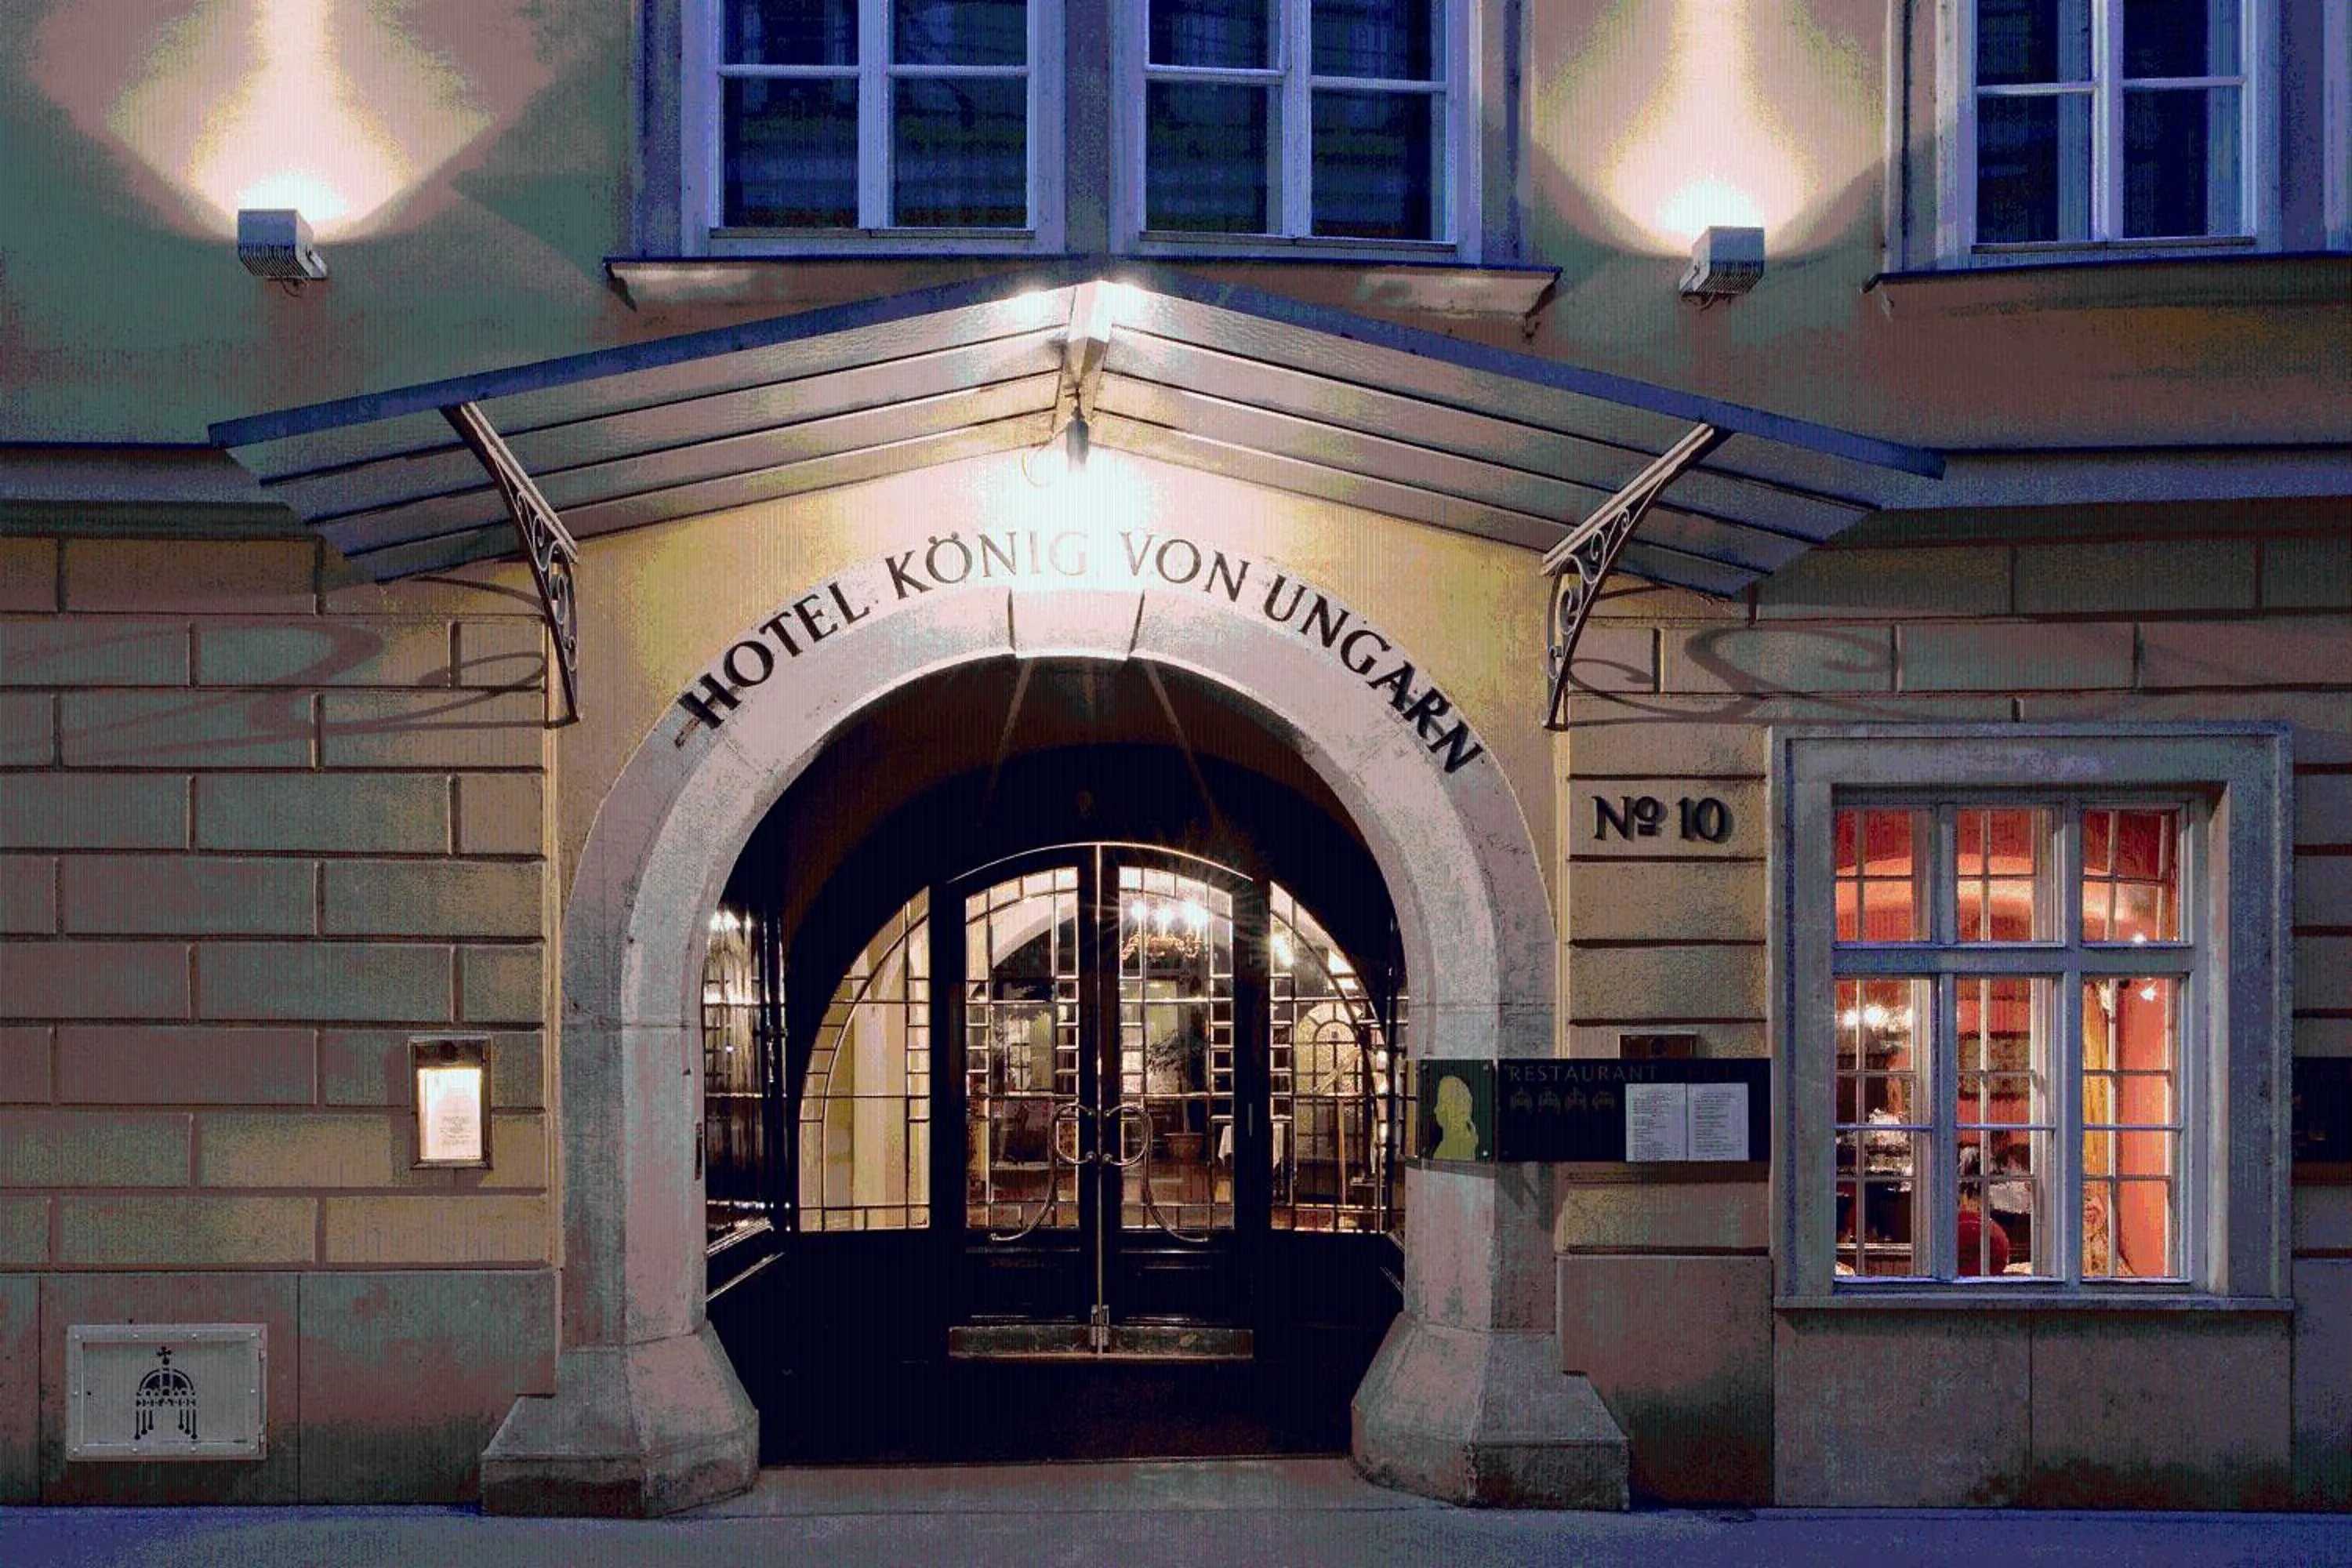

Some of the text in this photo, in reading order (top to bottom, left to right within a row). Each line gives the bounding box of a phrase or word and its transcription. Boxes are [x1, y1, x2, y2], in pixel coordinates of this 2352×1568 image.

[677, 531, 1484, 774] HOTEL KÖNIG VON UNGARN
[1676, 796, 1734, 844] 10
[1508, 1064, 1659, 1083] RESTAURANT
